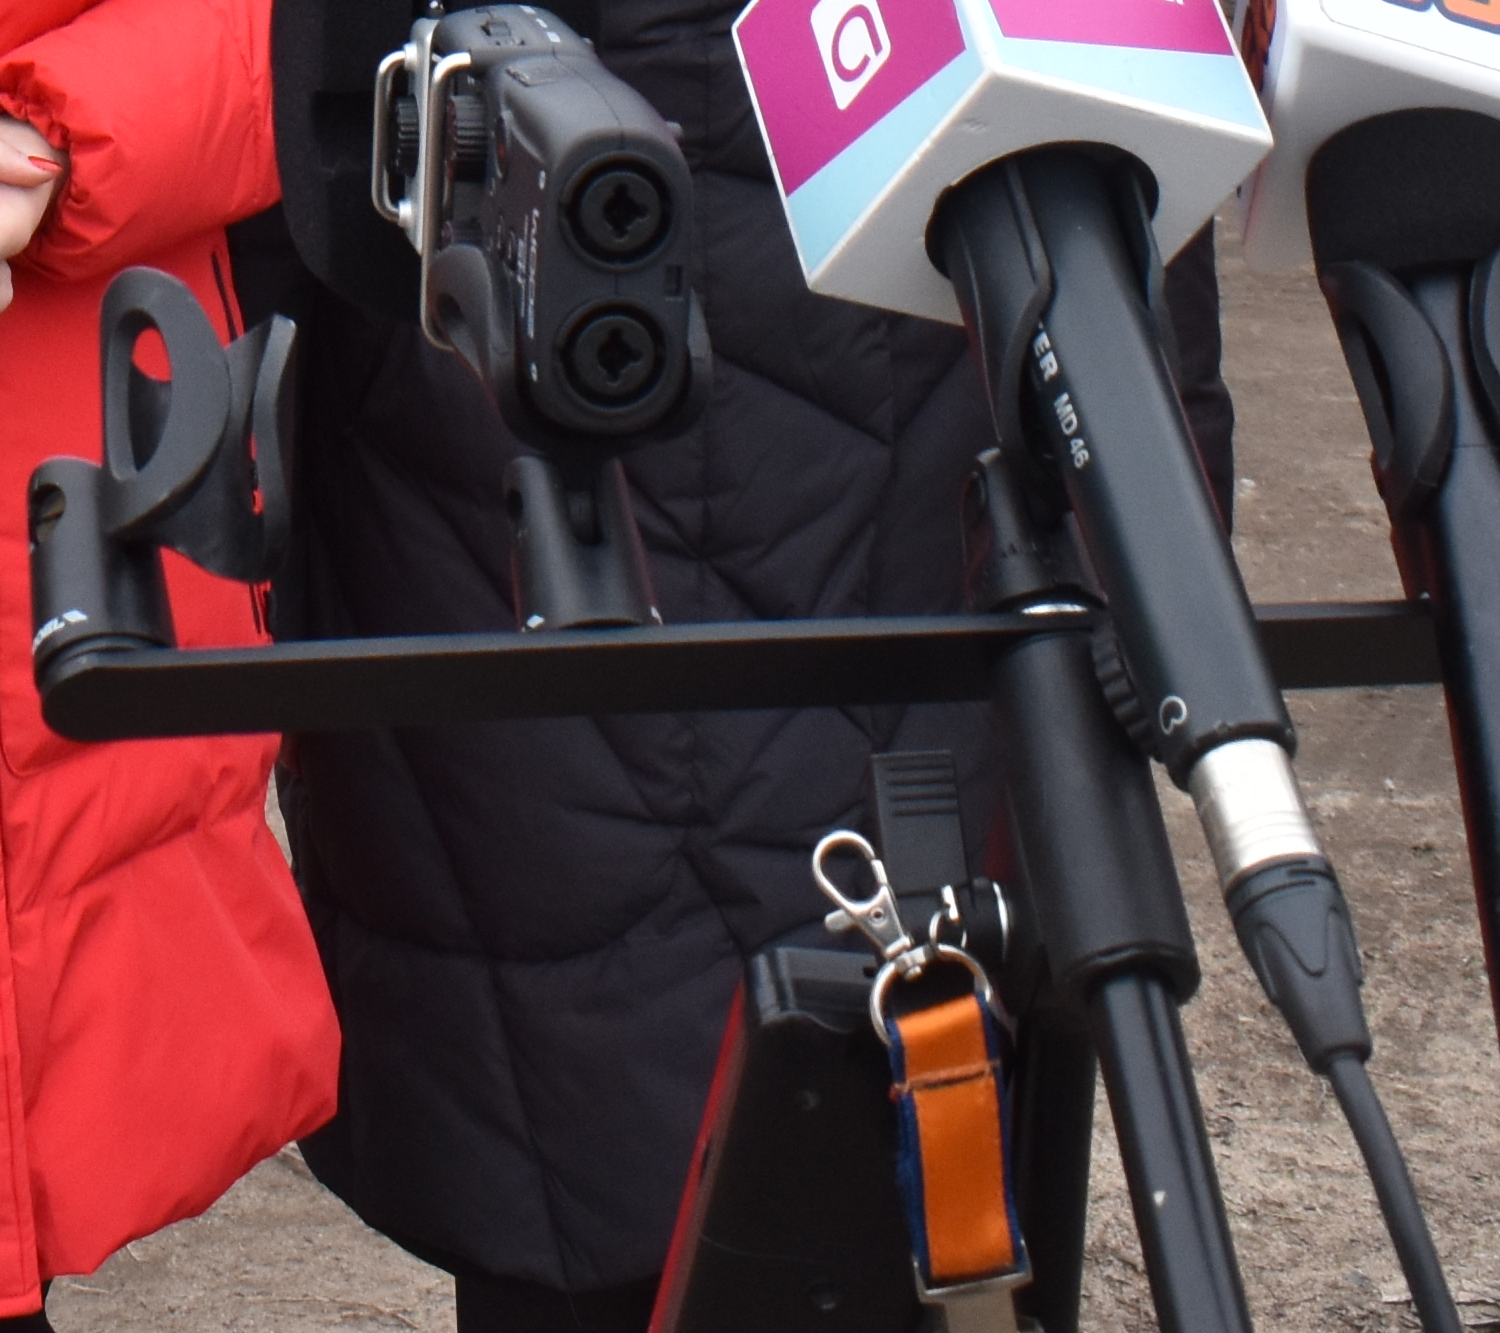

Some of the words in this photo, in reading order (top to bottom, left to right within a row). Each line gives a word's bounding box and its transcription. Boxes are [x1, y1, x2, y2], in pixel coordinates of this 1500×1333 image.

[1032, 321, 1059, 383] ER
[1053, 391, 1078, 437] MD
[1069, 437, 1090, 470] 46
